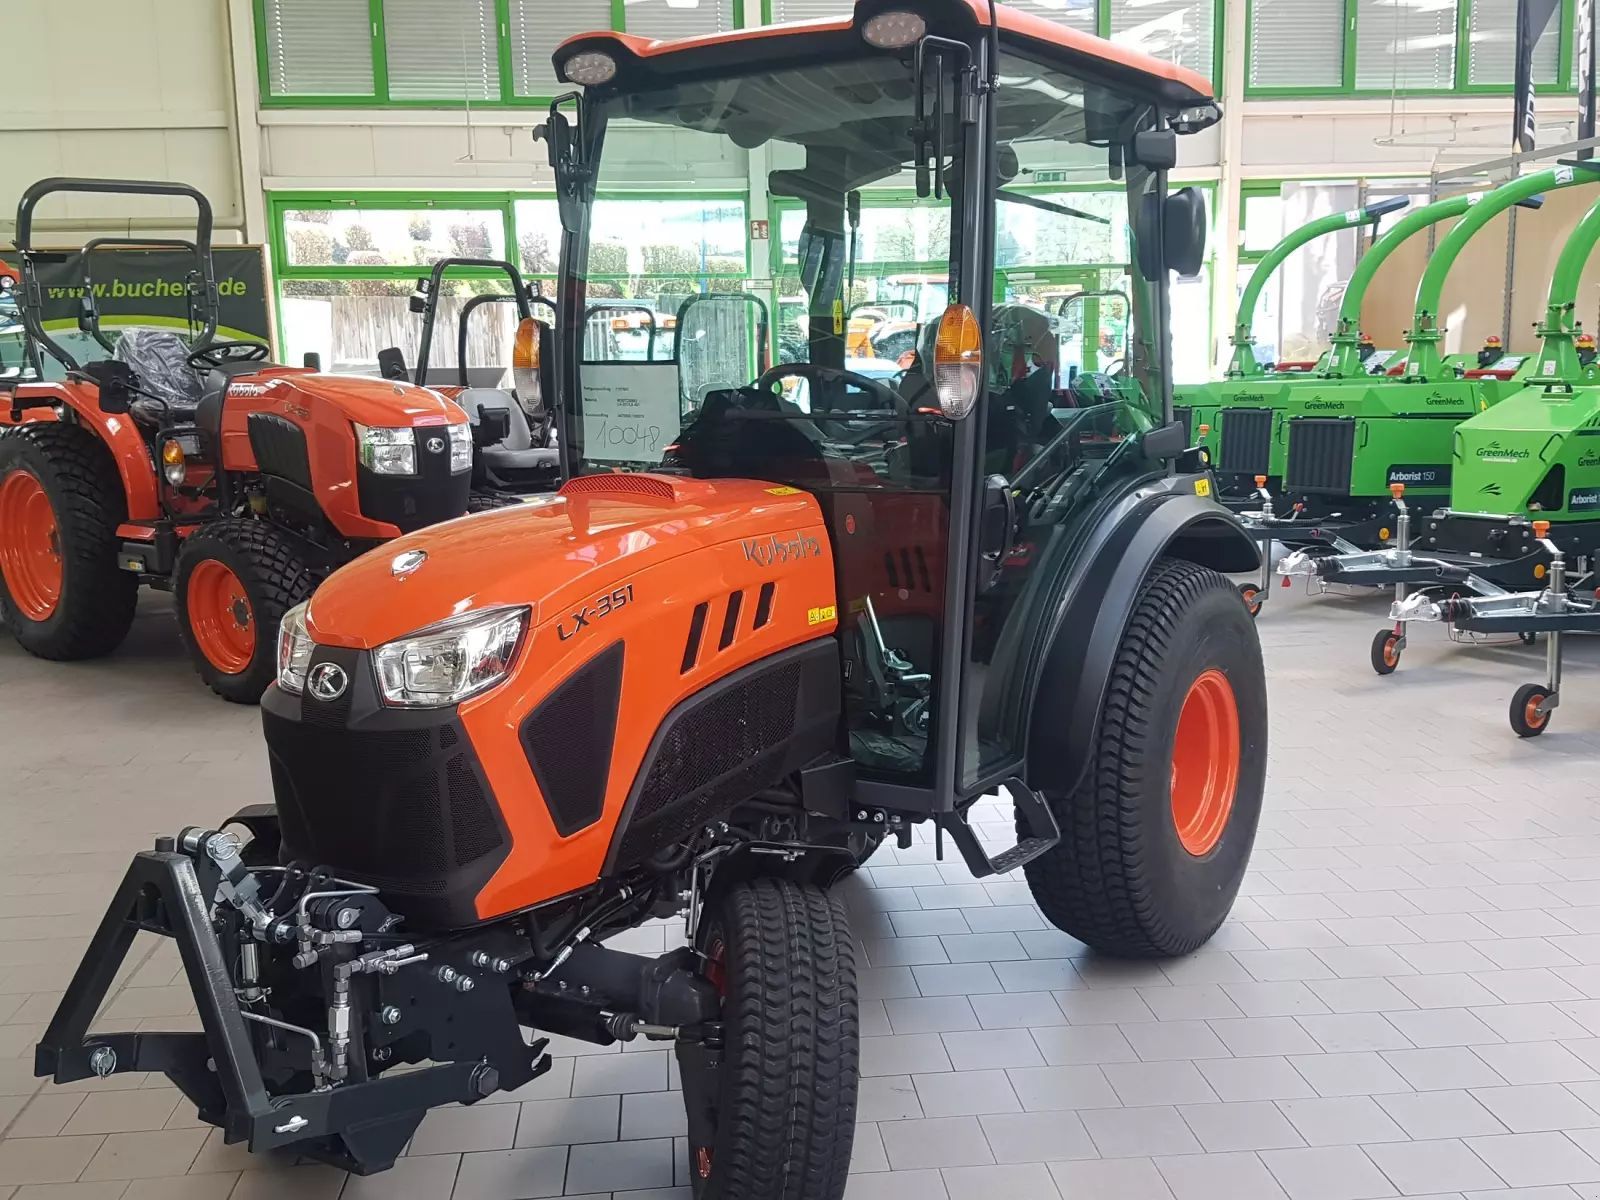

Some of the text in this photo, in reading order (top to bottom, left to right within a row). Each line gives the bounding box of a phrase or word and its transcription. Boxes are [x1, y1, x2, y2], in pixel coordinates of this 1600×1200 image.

[1304, 400, 1345, 410] GreenMech
[1426, 397, 1465, 406] GreenMech
[596, 421, 660, 452] 10048
[1476, 447, 1530, 459] GreenMech
[1578, 456, 1600, 466] Green
[1390, 471, 1435, 481] Arborist 150
[1571, 494, 1597, 505] Arborist
[741, 531, 821, 567] Kubota
[556, 583, 634, 641] LX-351
